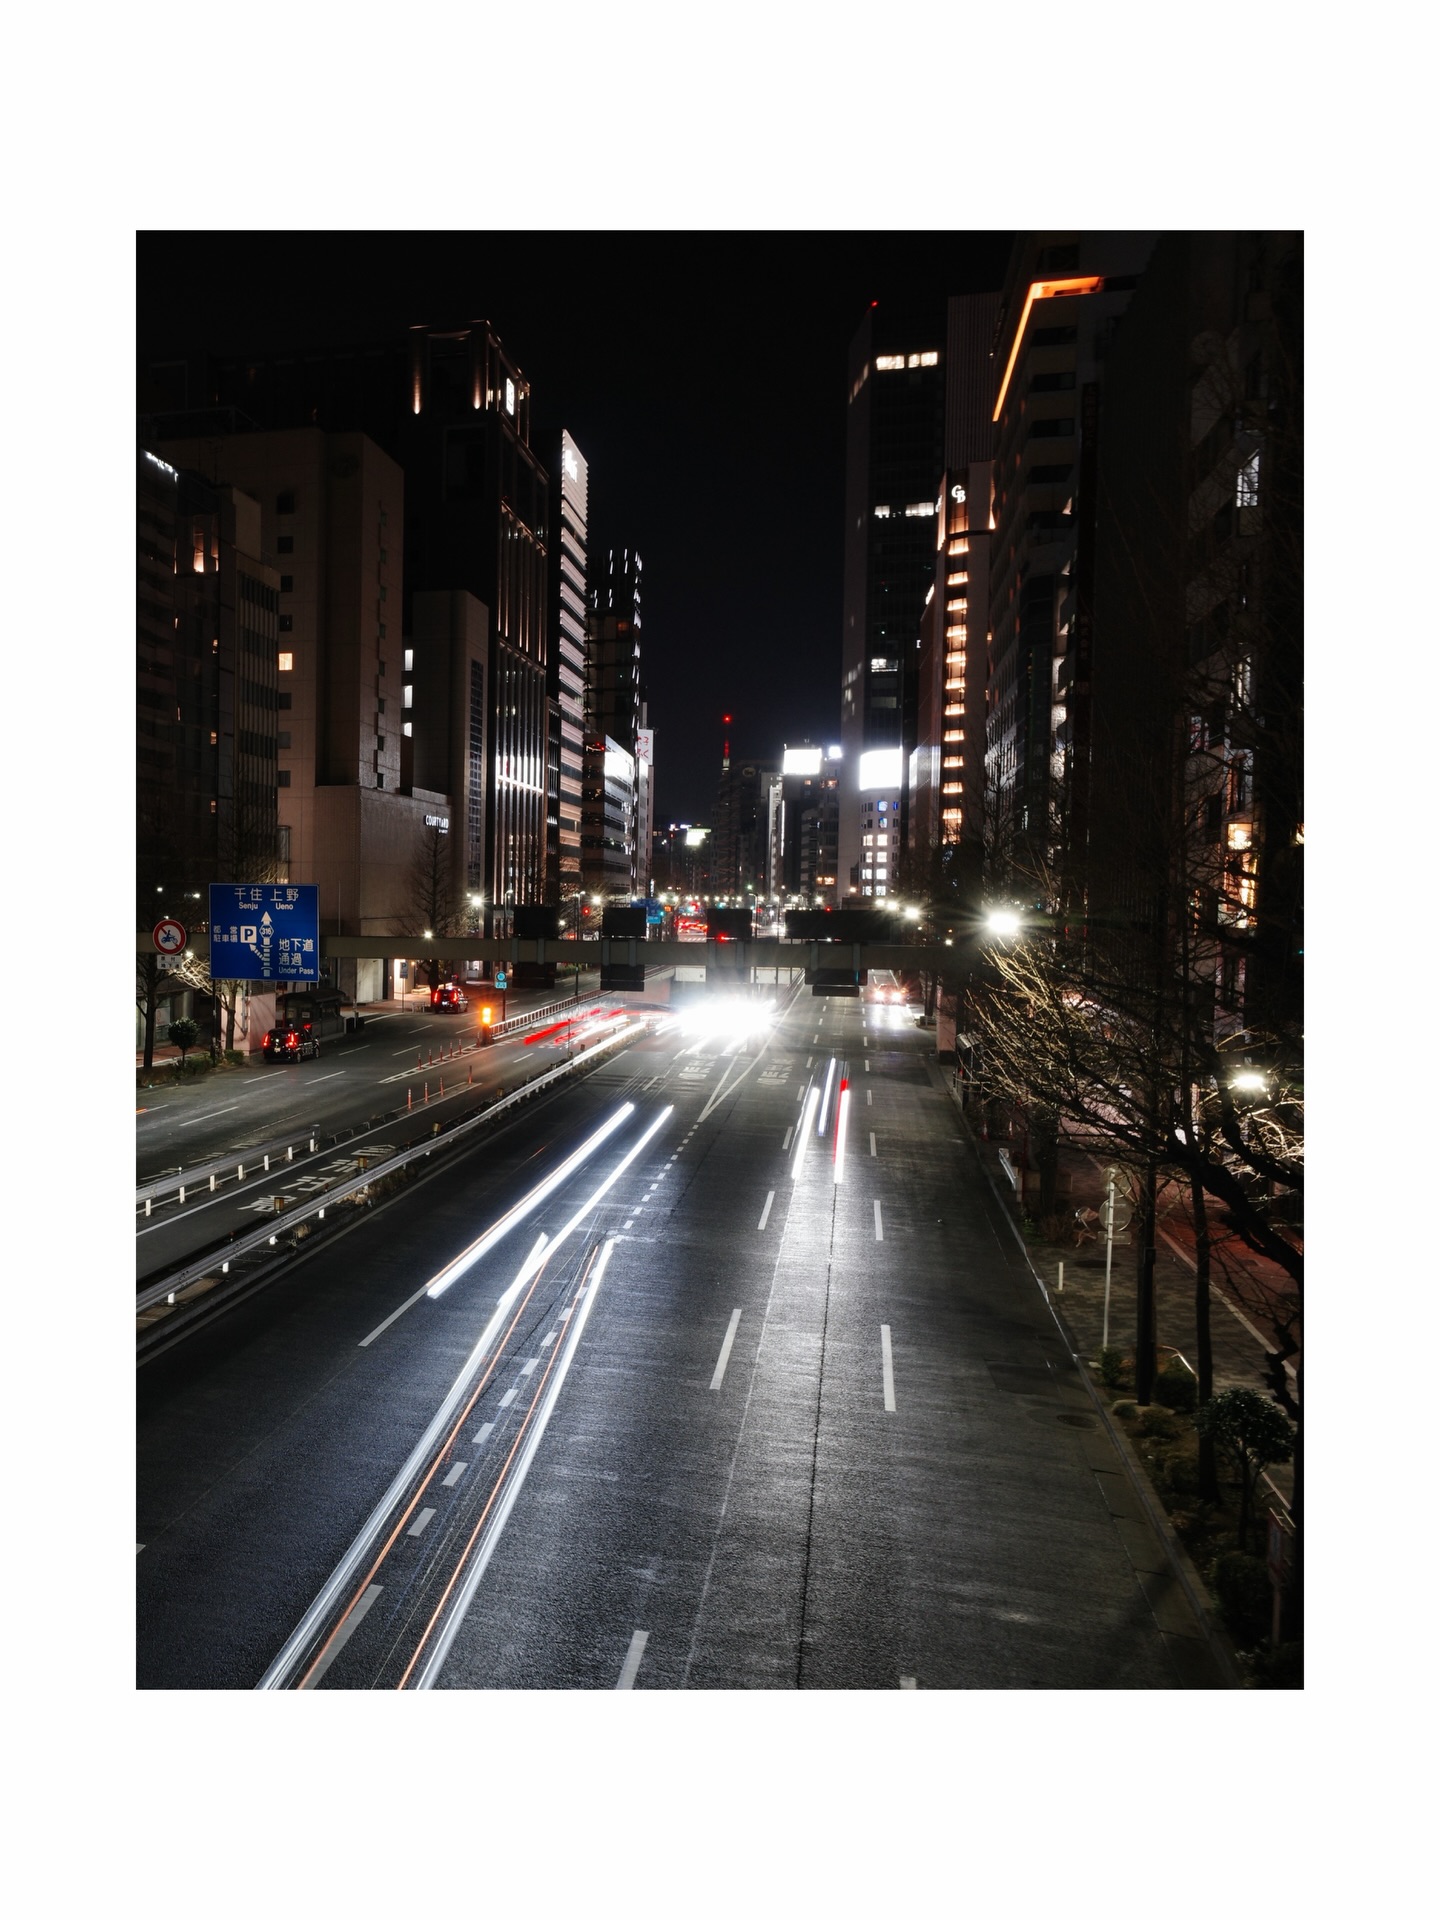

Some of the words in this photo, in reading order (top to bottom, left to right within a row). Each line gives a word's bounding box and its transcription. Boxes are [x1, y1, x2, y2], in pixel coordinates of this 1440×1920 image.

[234, 887, 263, 901] 千住
[270, 888, 299, 902] 上野
[238, 902, 258, 910] Senju
[275, 902, 294, 910] Ueno
[213, 934, 238, 943] 駐車場
[244, 928, 254, 941] P
[279, 938, 314, 952] 地下道
[279, 953, 302, 966] 通過
[279, 967, 297, 975] Under
[299, 967, 314, 975] Pass
